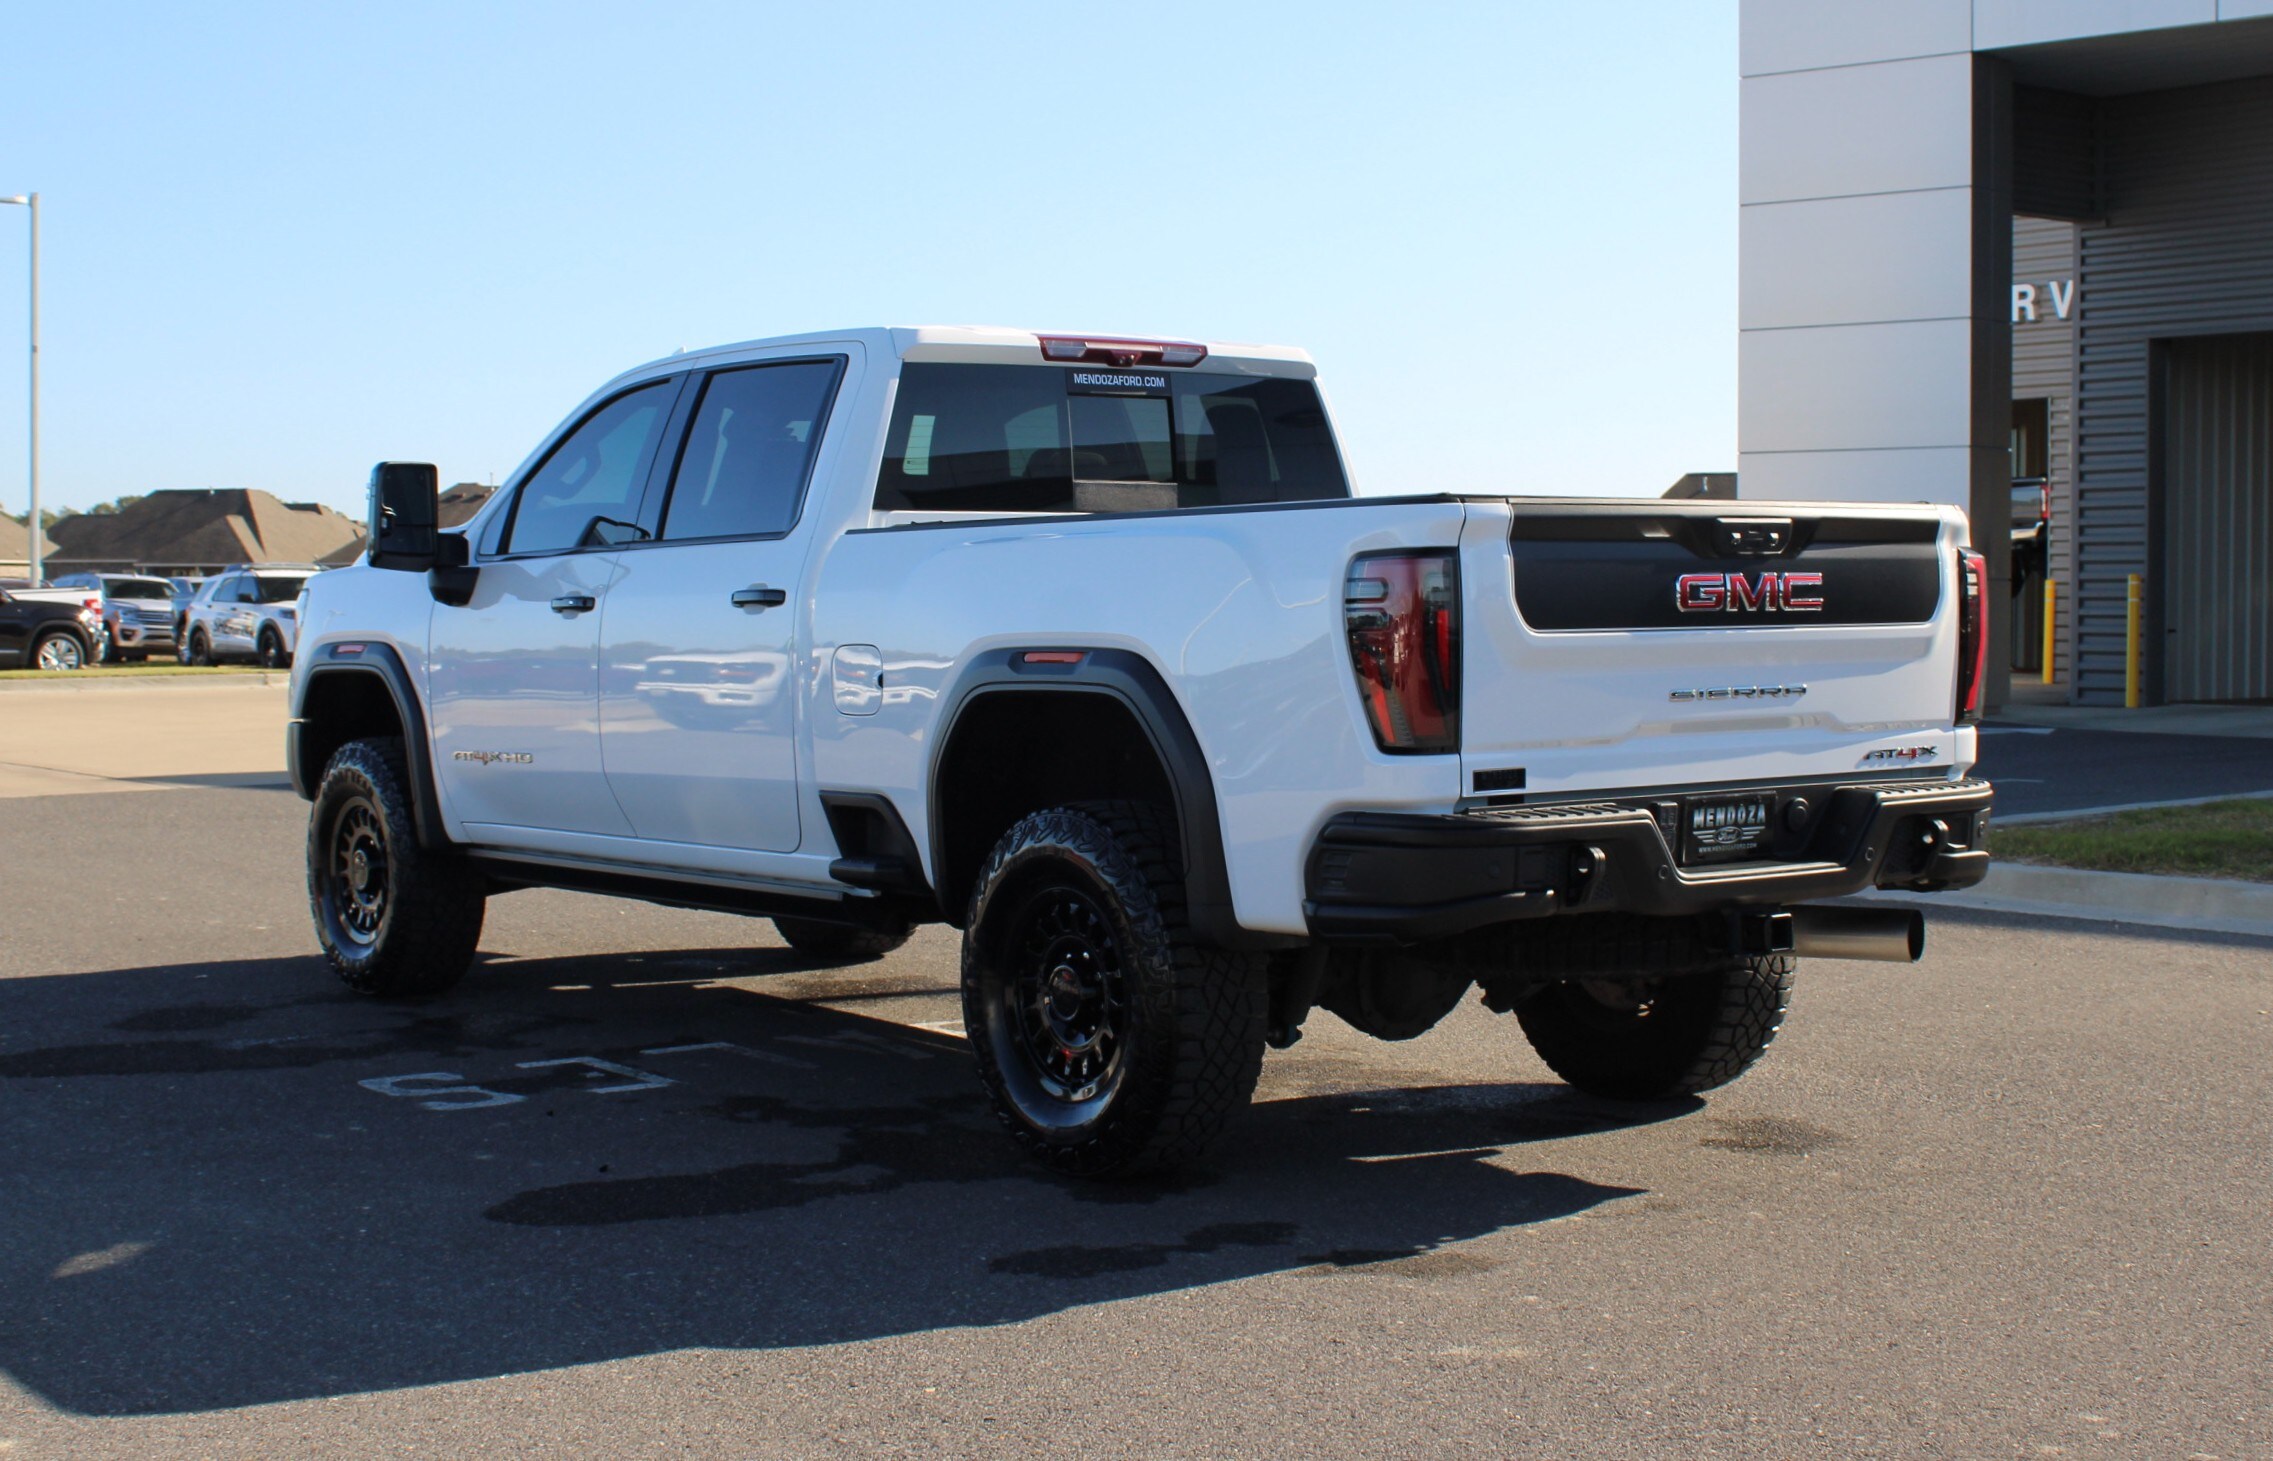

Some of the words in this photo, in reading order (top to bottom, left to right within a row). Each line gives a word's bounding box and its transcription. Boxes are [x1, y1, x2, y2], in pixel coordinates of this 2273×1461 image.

[1073, 372, 1165, 388] MENDOZAFORD.COM
[1676, 572, 1824, 612] GMC
[1669, 683, 1807, 701] SIERRA
[1863, 745, 1938, 761] AT4X
[1693, 804, 1766, 828] MENDOZA
